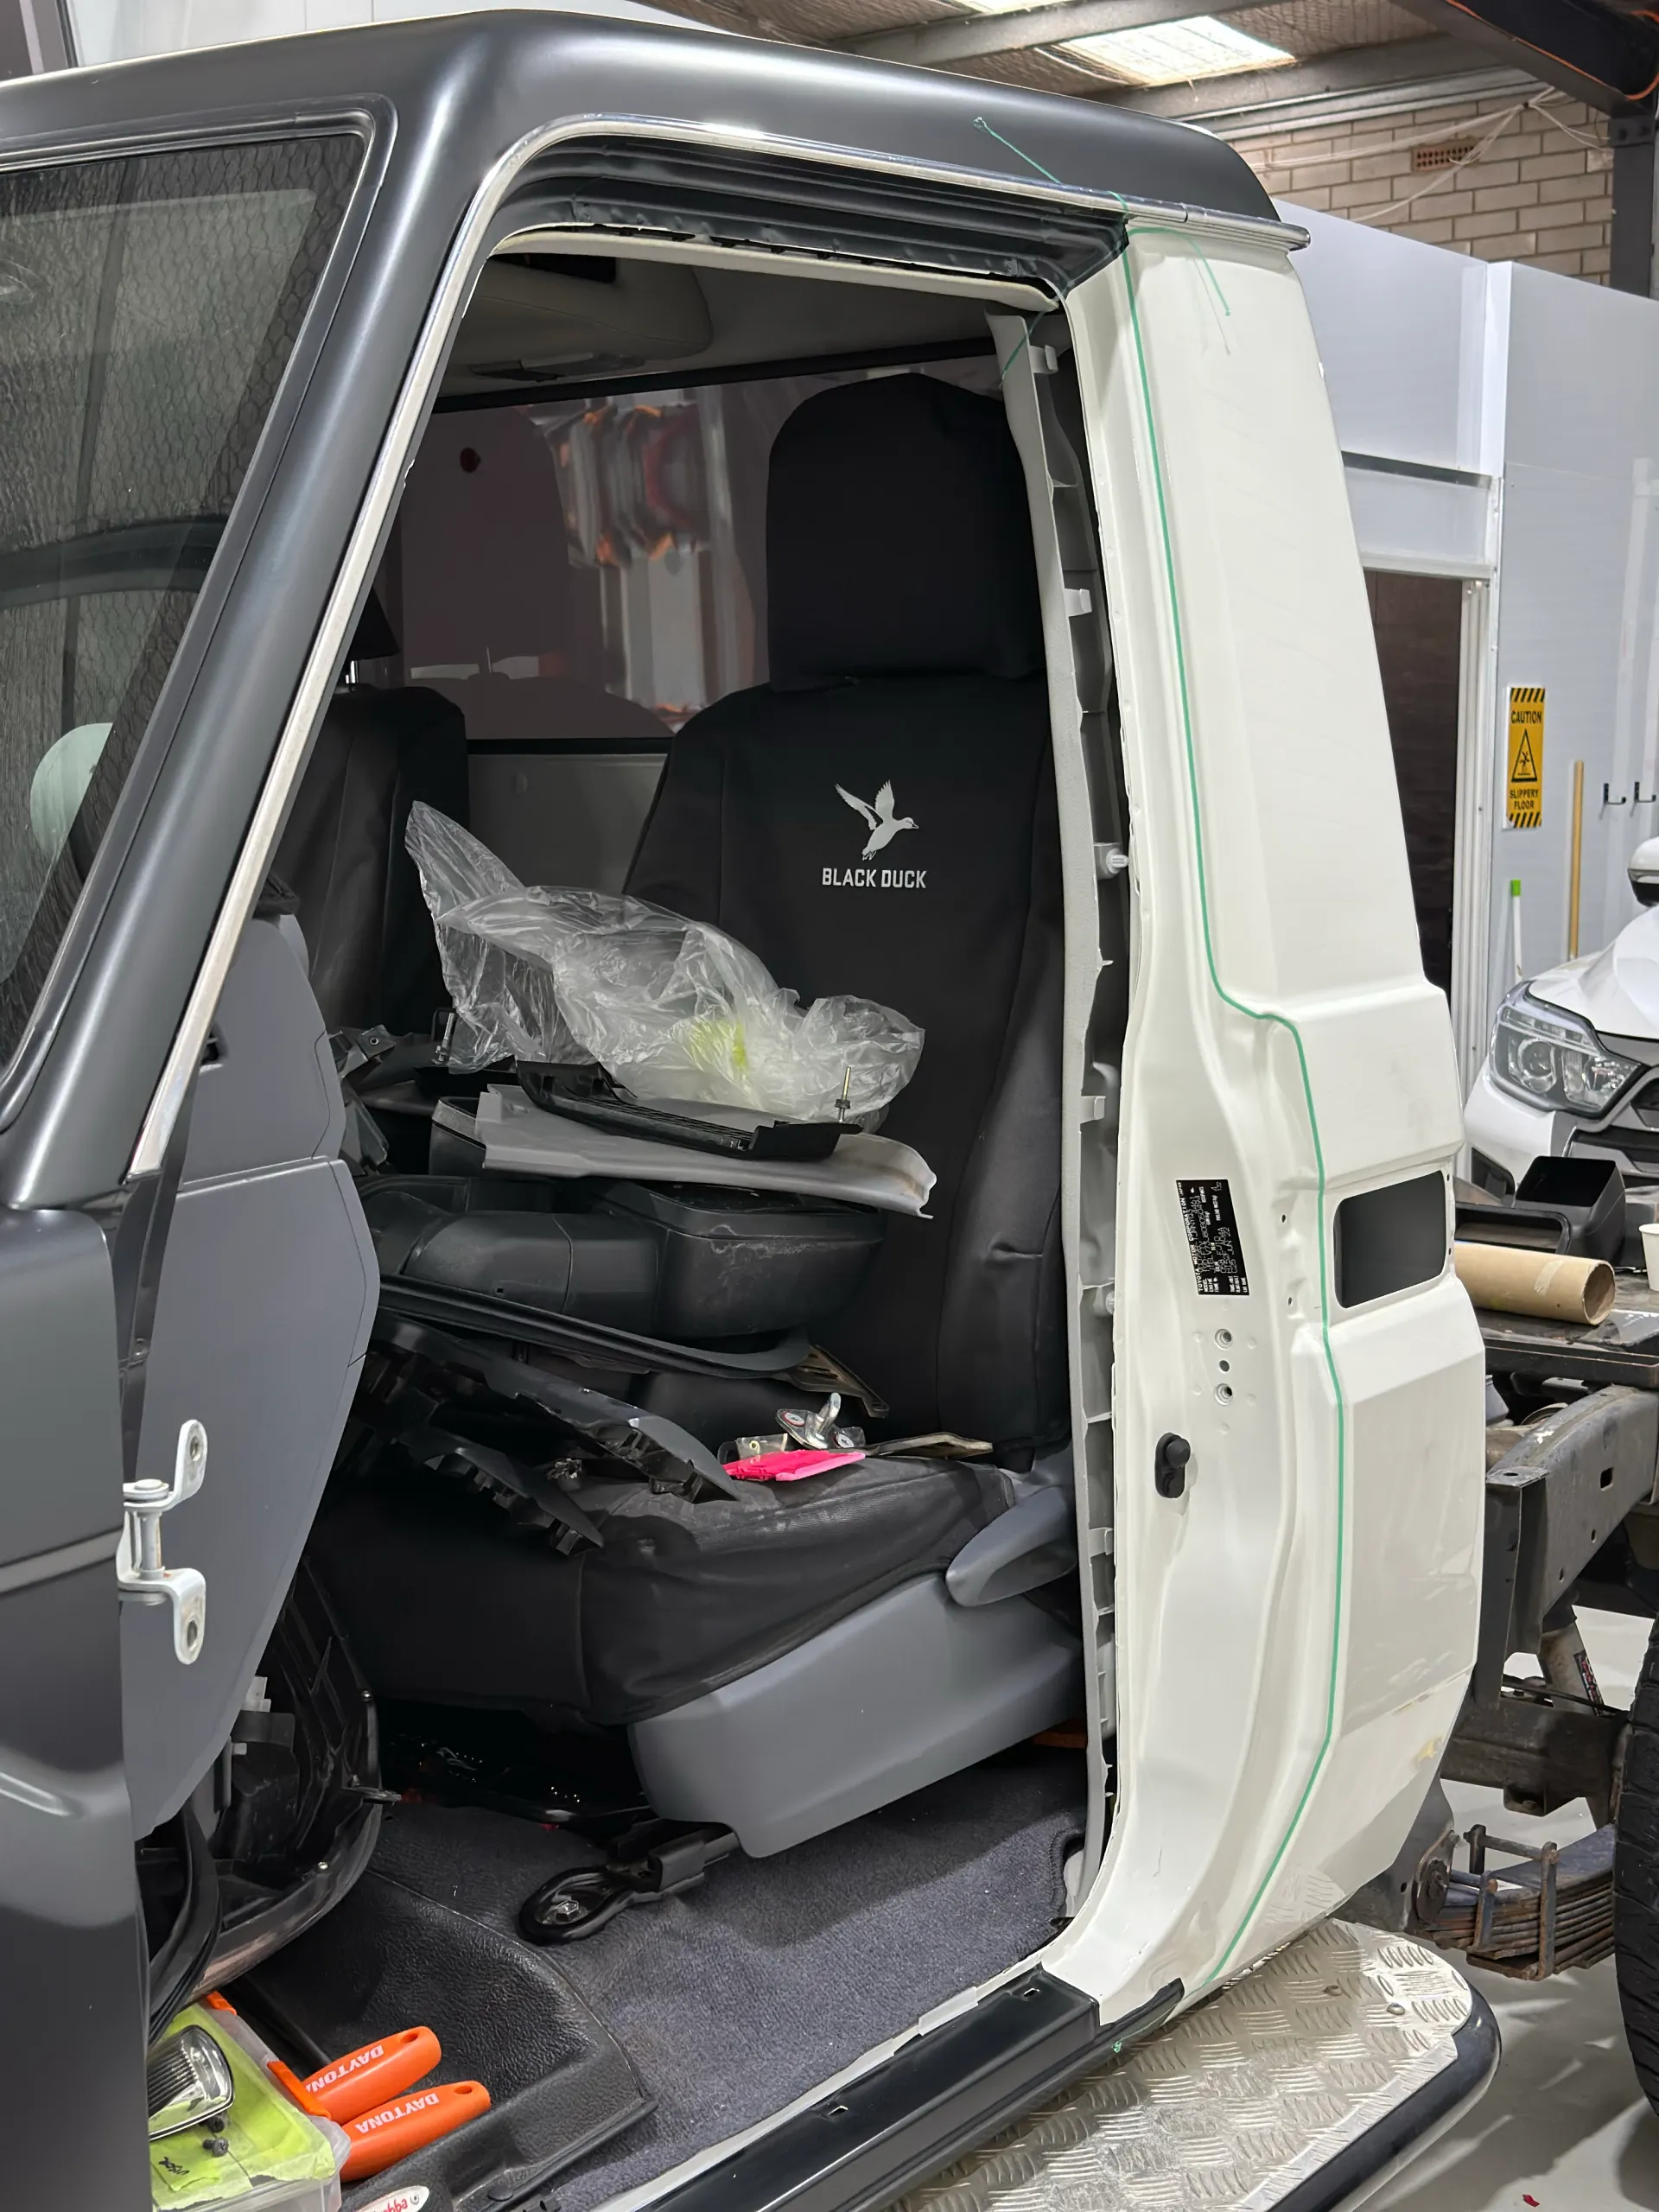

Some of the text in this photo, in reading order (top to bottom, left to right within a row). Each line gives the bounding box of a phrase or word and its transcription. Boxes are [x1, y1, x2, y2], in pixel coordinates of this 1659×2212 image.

[1510, 710, 1542, 724] CAUTION
[1510, 789, 1539, 798] SLIPPERY
[1514, 800, 1535, 810] FLOOR
[822, 868, 927, 889] BLACK DUCK
[1180, 1198, 1193, 1241] CORPORATION
[354, 2092, 441, 2134] DAYTONA
